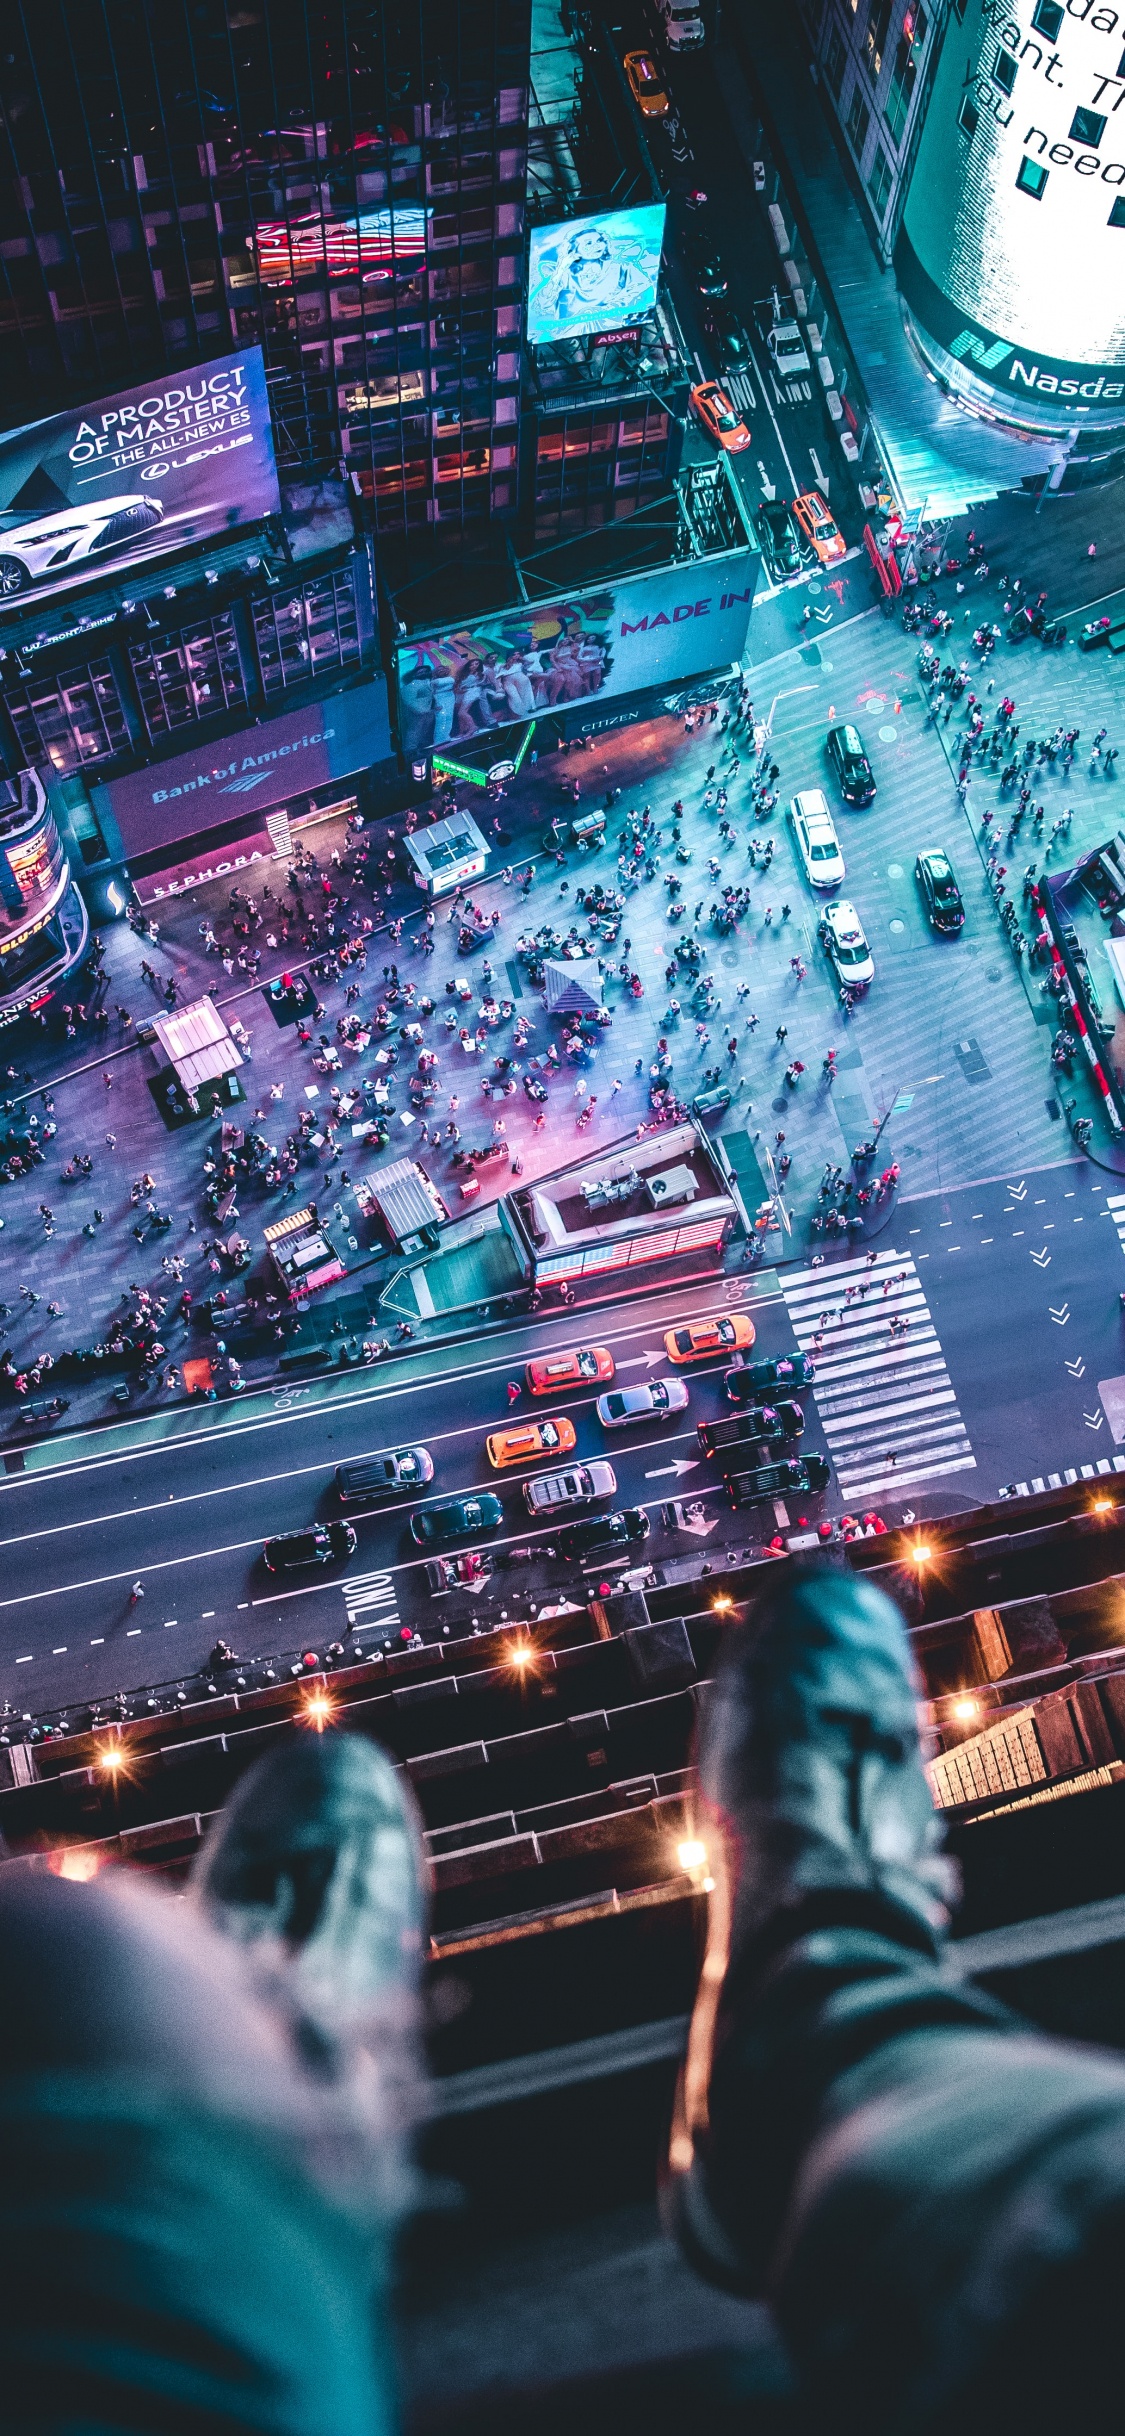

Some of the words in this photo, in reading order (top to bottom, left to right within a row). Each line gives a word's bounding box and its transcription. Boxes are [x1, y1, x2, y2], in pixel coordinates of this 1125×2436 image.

[981, 0, 1063, 88] want.
[962, 57, 1014, 128] you
[597, 331, 637, 343] Absen
[68, 435, 109, 462] OF
[116, 386, 247, 447] MASTERY
[75, 421, 97, 442] A
[101, 366, 245, 432] PRODUCT
[112, 449, 146, 467] THE
[150, 418, 225, 455] ALL-NEW
[230, 409, 251, 426] ES
[171, 433, 254, 468] LEXUS
[620, 598, 712, 637] MADE
[719, 588, 751, 610] IN
[581, 711, 639, 731] CITIZEN
[152, 774, 211, 804] Bank
[214, 762, 238, 780] of
[241, 728, 336, 771] America
[153, 851, 263, 898] SEPHORA
[341, 1574, 401, 1632] ONLY
